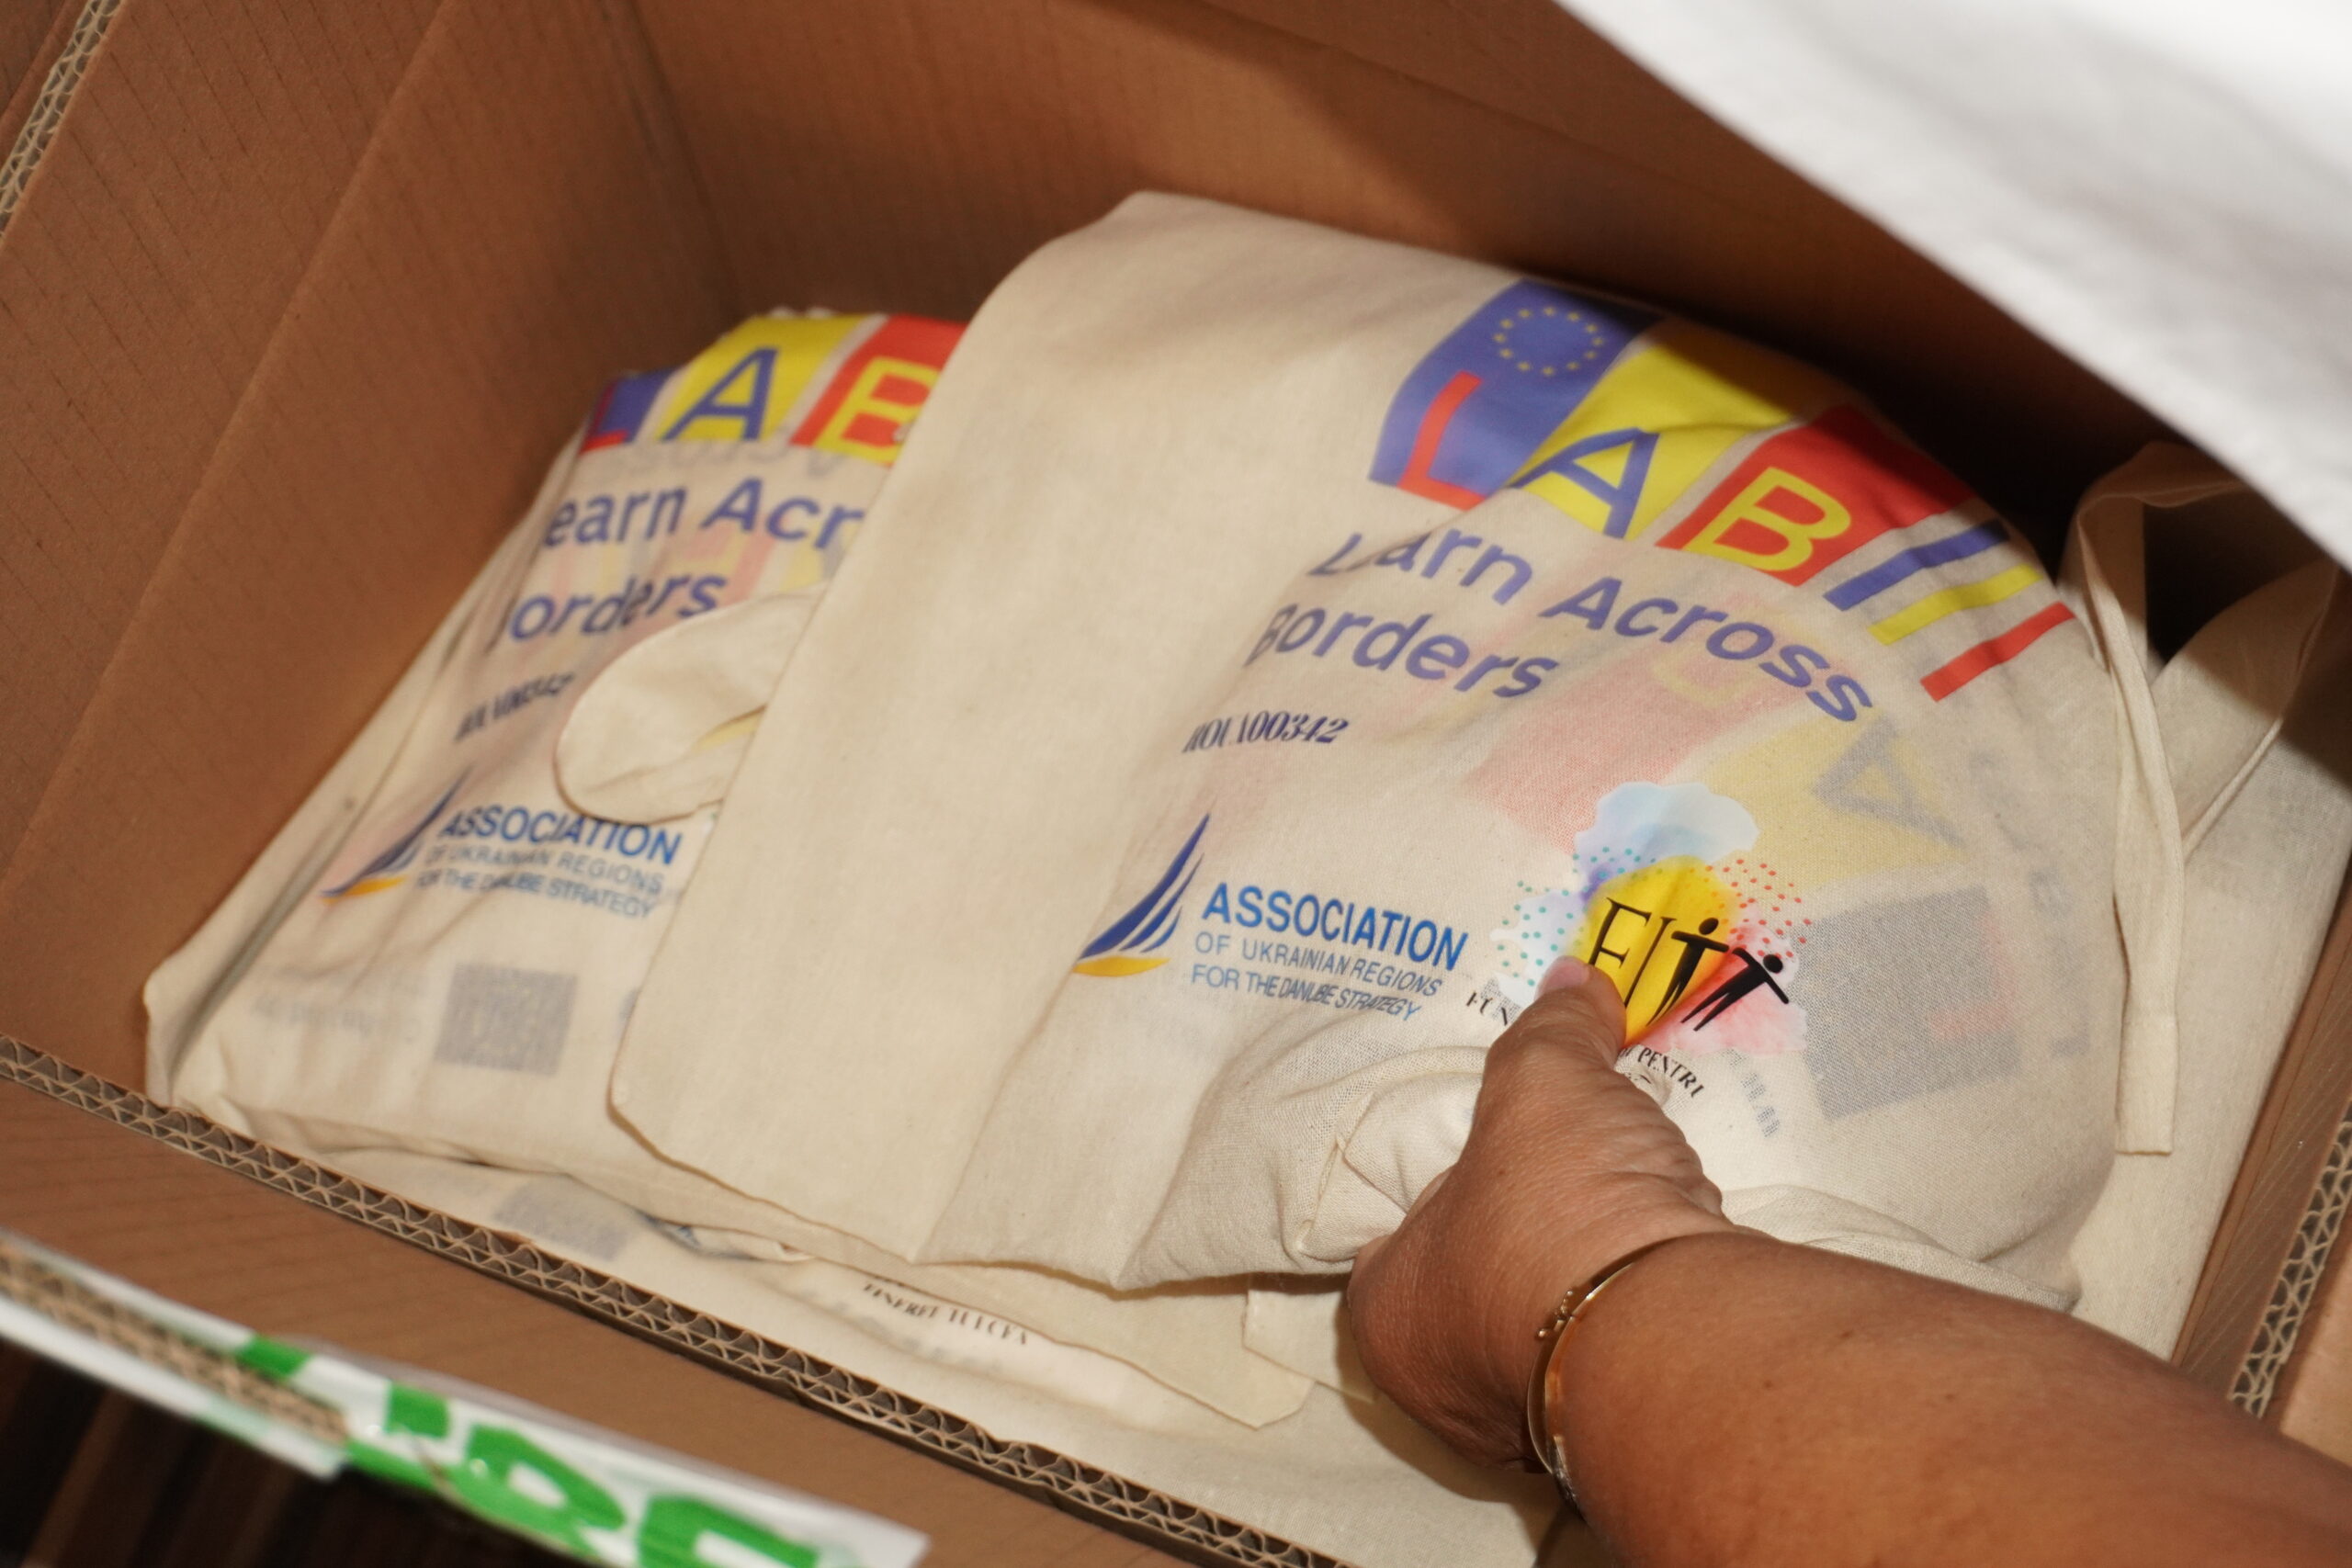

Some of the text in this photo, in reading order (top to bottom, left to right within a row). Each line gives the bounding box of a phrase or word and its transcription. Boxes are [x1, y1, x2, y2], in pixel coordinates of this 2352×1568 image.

[1396, 370, 1852, 572] LAB
[542, 476, 865, 550] earn Acr
[508, 572, 728, 641] orders
[1243, 603, 1560, 698] Borders
[1537, 575, 1874, 723] Across
[439, 804, 683, 865] ASSOCIATION
[547, 876, 660, 919] STRATEGY
[556, 851, 664, 896] REGIONS
[1201, 882, 1469, 972] ASSOCIATION
[1191, 964, 1421, 1021] FOR THE DANUBE STRATEGY
[1194, 931, 1443, 997] OF UKRAINIAN REGIONS
